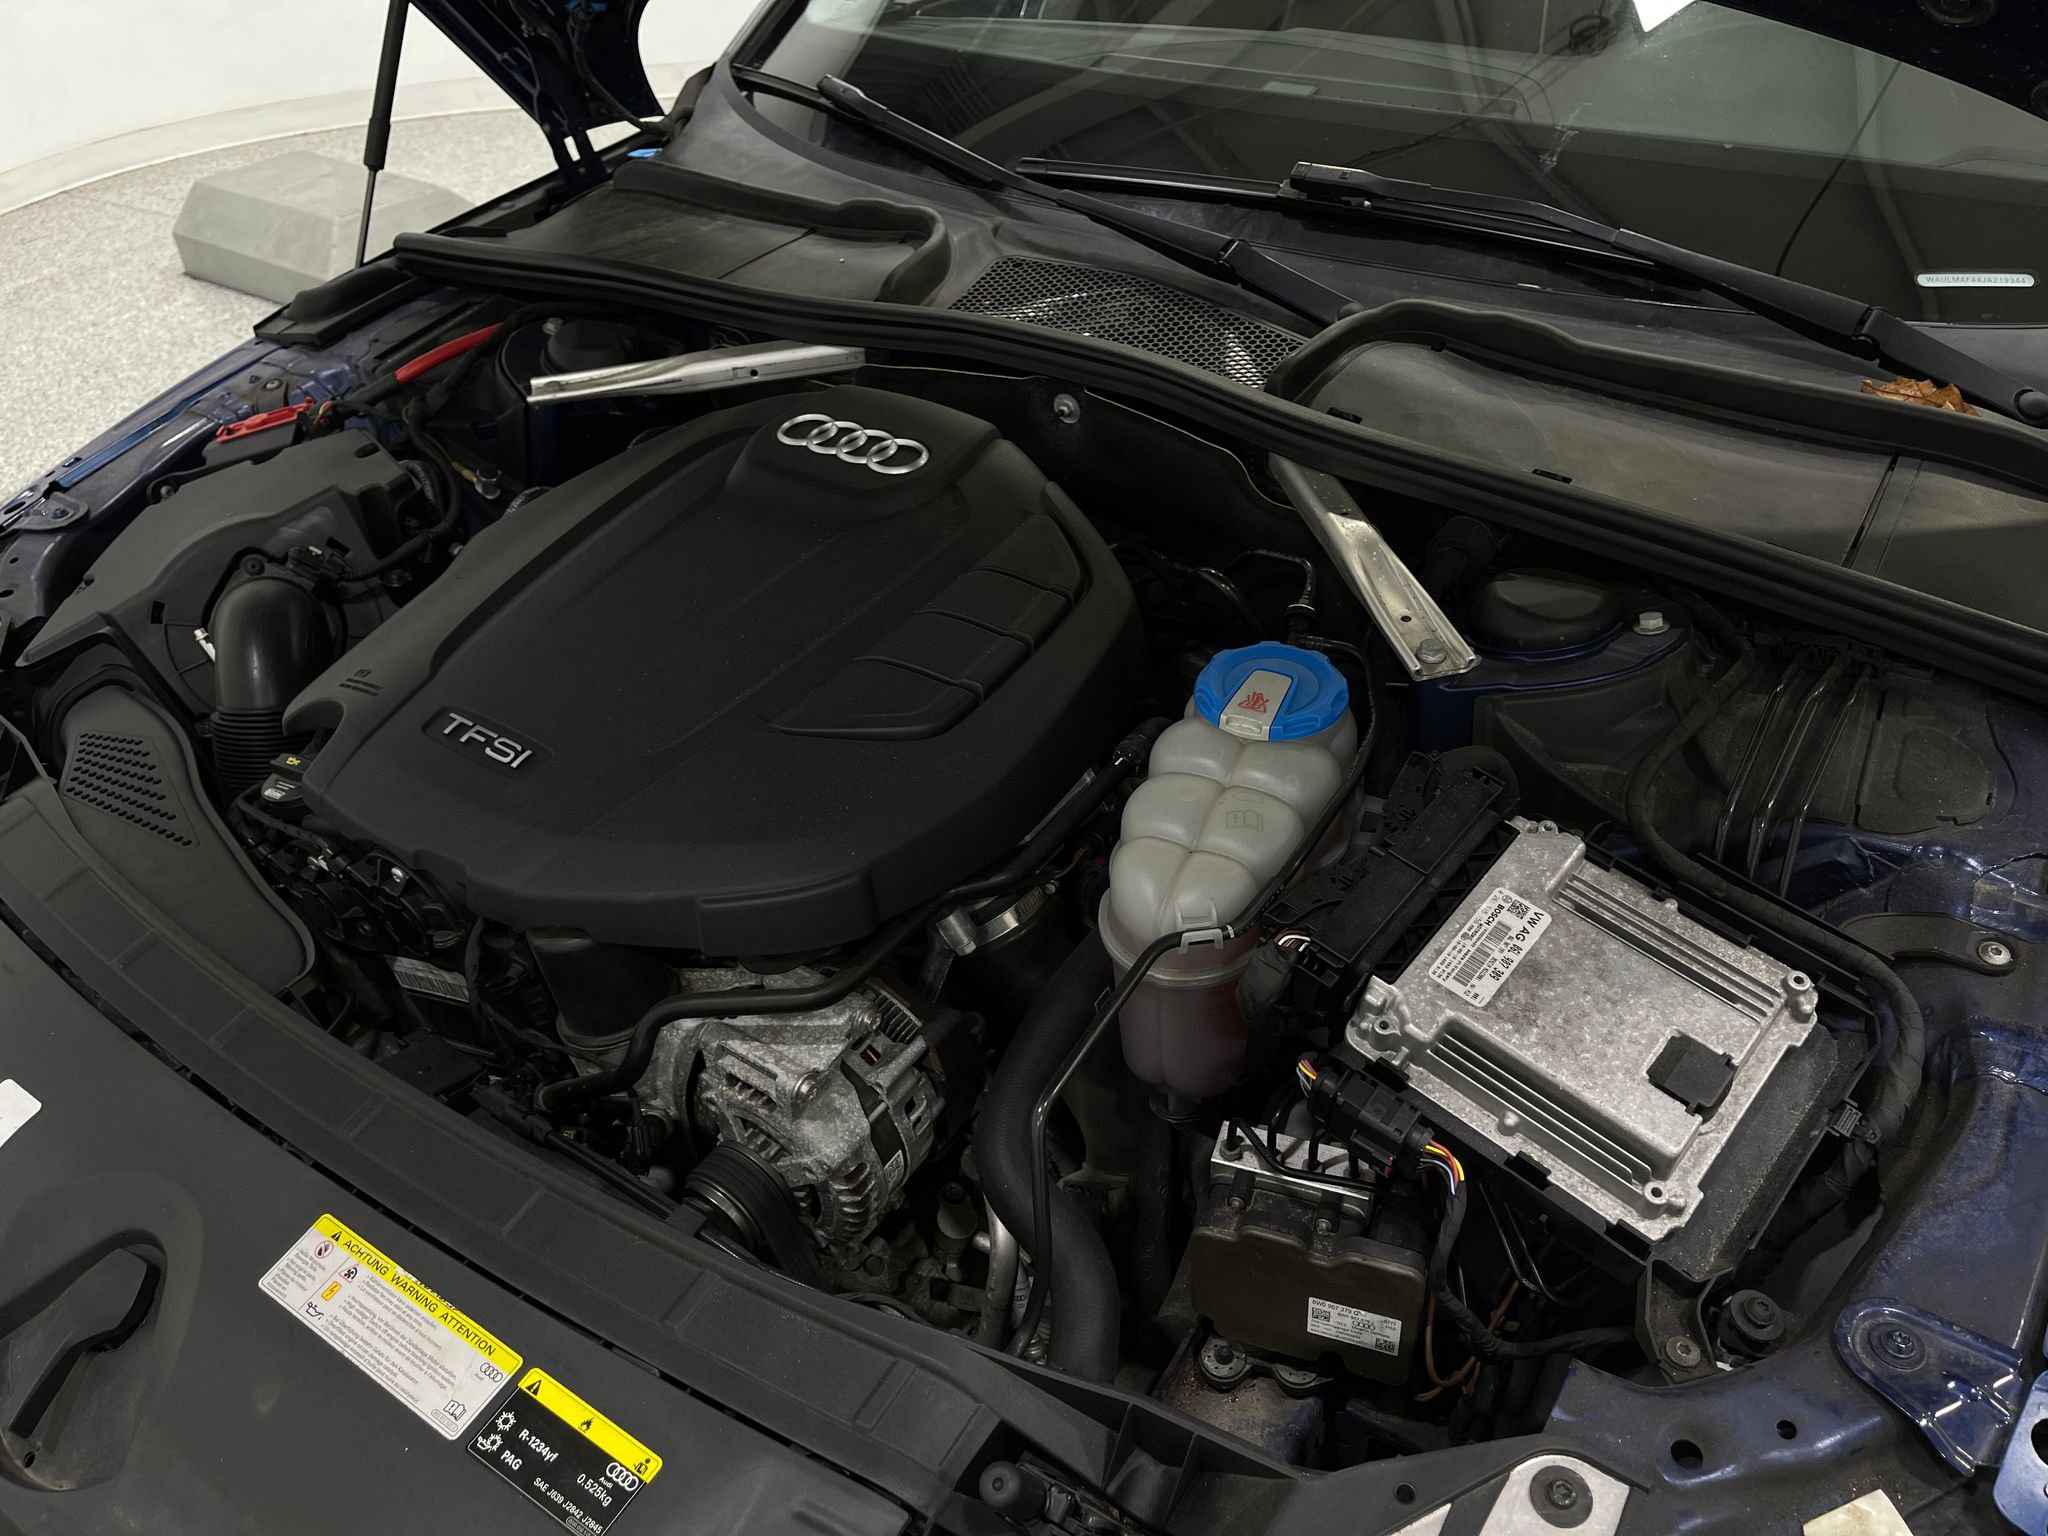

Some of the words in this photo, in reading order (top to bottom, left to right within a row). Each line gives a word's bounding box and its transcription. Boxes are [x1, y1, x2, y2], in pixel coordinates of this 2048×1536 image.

[442, 712, 533, 769] TFSI
[1484, 903, 1505, 926] BOSCH
[1525, 910, 1544, 928] VW
[1514, 925, 1532, 943] AG
[342, 1238, 390, 1276] ACHTUNG
[388, 1272, 440, 1314] WARNING
[437, 1309, 497, 1357] ATTENTION
[500, 1449, 523, 1471] PAG
[518, 1429, 560, 1463] R-1234yf
[576, 1473, 613, 1508] 0.525kg
[599, 1476, 614, 1490] Audi
[533, 1477, 550, 1493] SAE
[546, 1488, 564, 1504] J639
[562, 1498, 584, 1520] J2842
[581, 1513, 603, 1535] J2845
